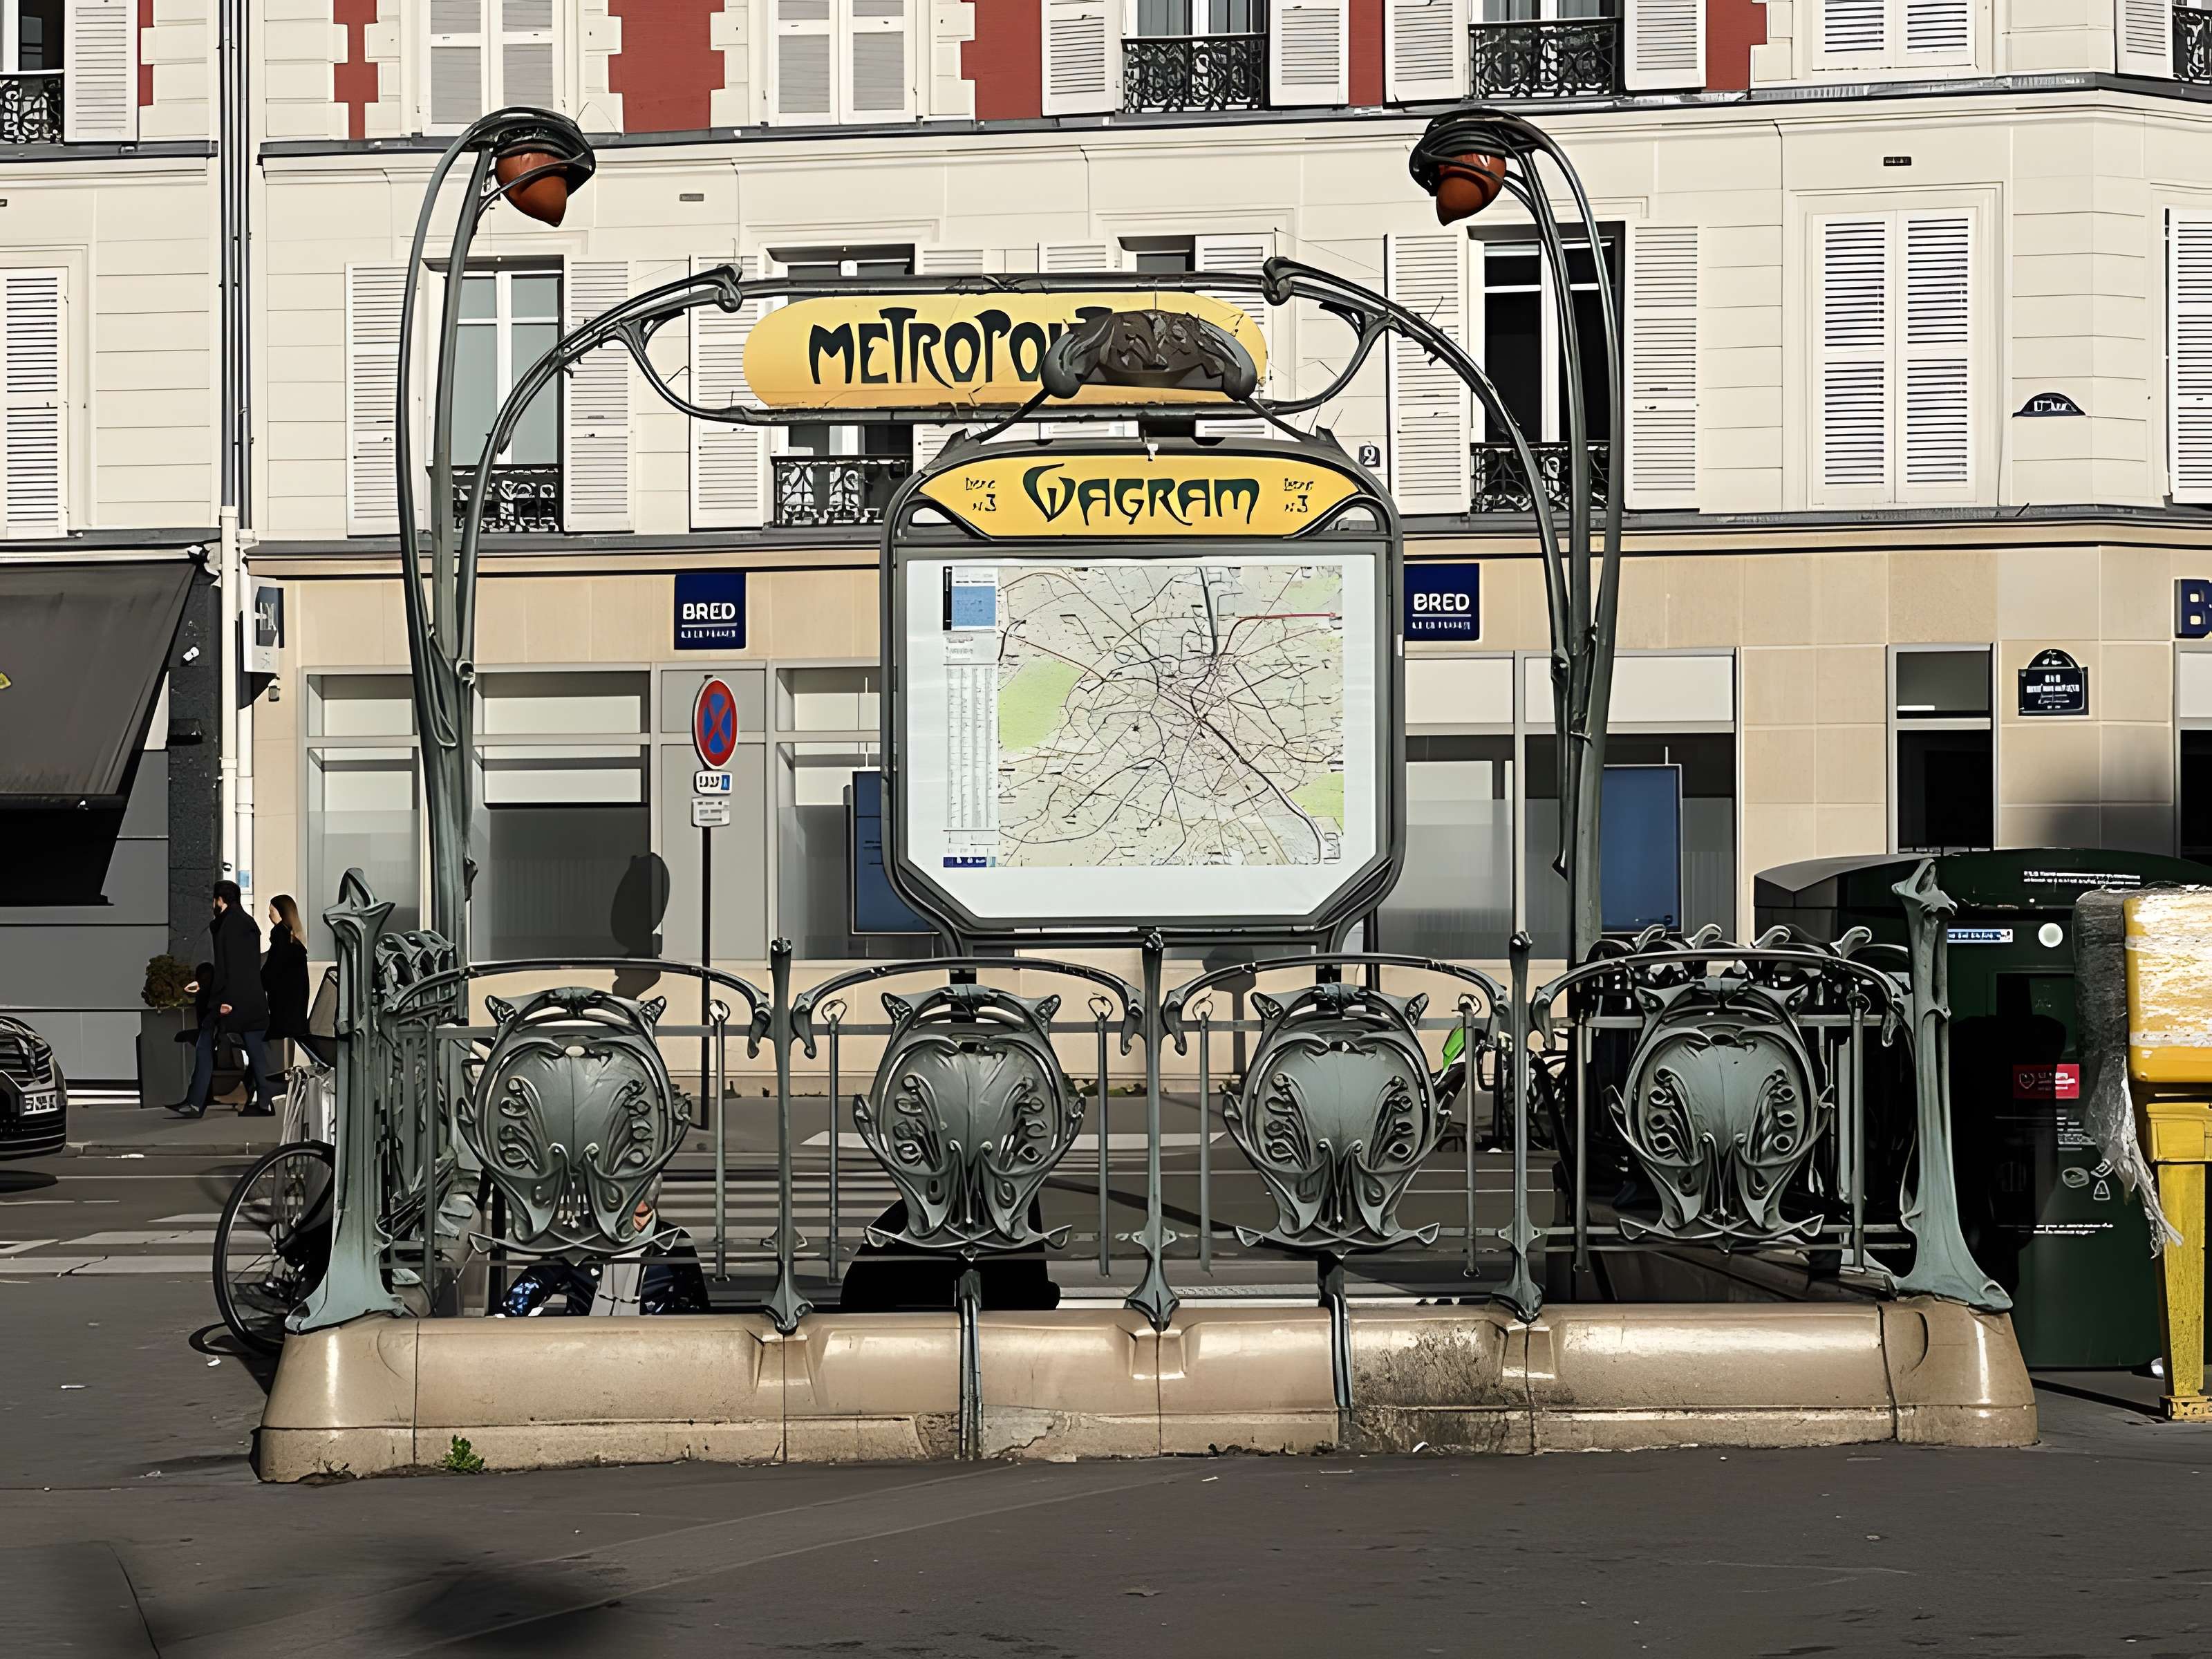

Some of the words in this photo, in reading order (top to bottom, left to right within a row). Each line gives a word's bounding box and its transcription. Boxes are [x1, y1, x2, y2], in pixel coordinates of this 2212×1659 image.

[809, 307, 1112, 389] METROPO
[1364, 446, 1376, 465] 2
[1023, 462, 1260, 526] WAGRAM
[682, 602, 736, 620] BRED
[1414, 593, 1470, 612] BRED
